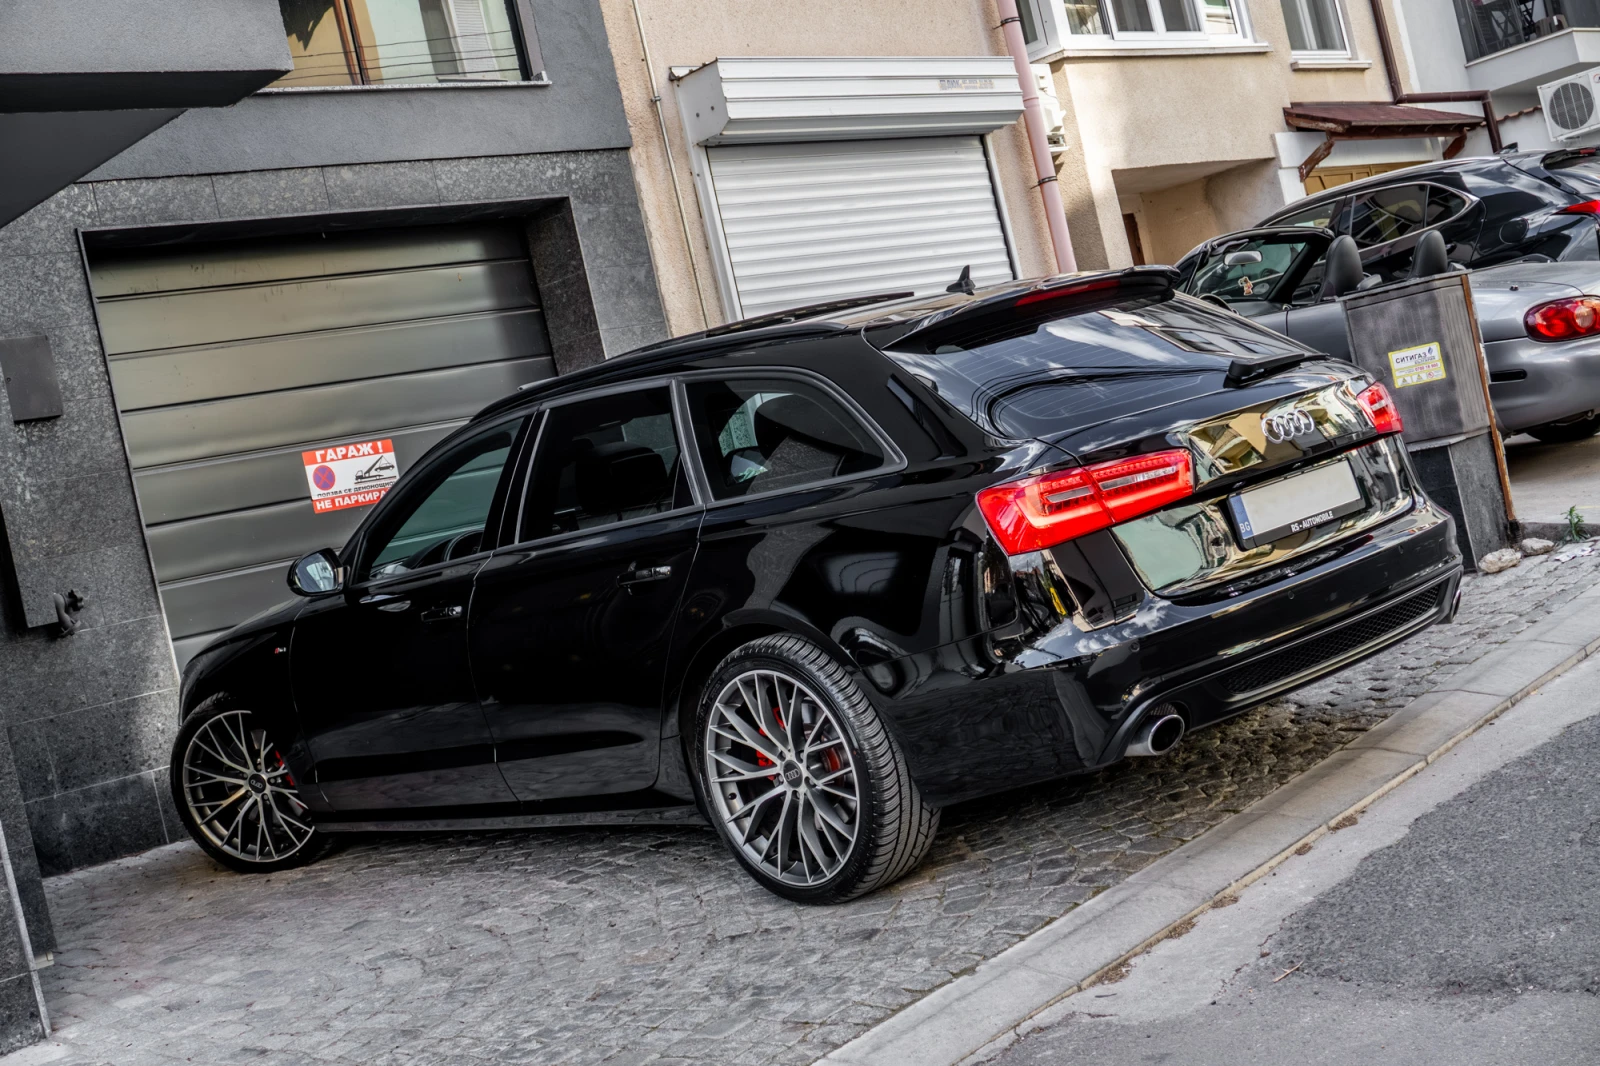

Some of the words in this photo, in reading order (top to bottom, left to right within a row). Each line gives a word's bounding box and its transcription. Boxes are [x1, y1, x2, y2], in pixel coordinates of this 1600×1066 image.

[1395, 352, 1427, 364] СИТИГАЗ
[315, 442, 374, 463] ГАРАЖ
[376, 441, 384, 453] !
[315, 499, 333, 510] НЕ
[1239, 521, 1251, 533] BG
